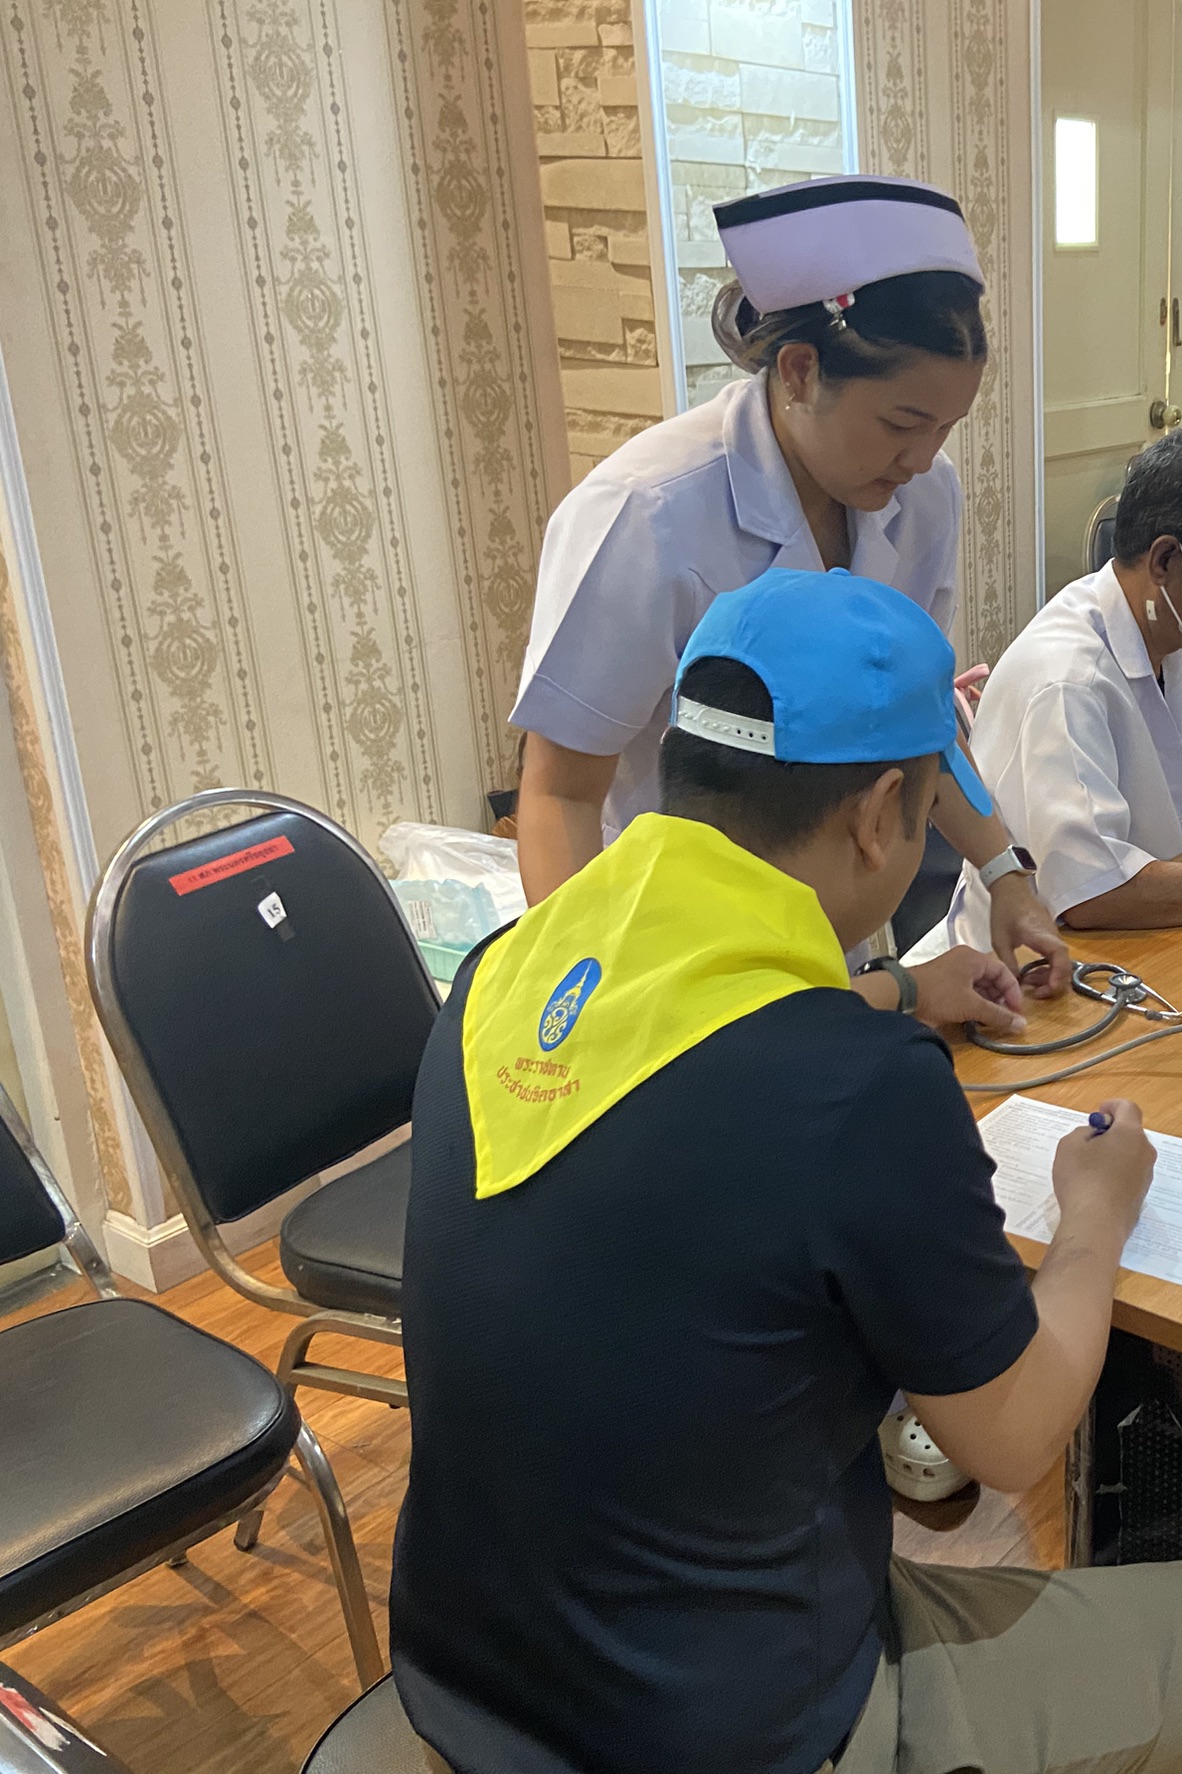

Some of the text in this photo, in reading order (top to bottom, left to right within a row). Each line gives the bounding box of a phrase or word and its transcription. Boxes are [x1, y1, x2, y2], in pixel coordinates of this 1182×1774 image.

[267, 902, 281, 918] 15
[514, 1057, 571, 1079] พระราชทาน
